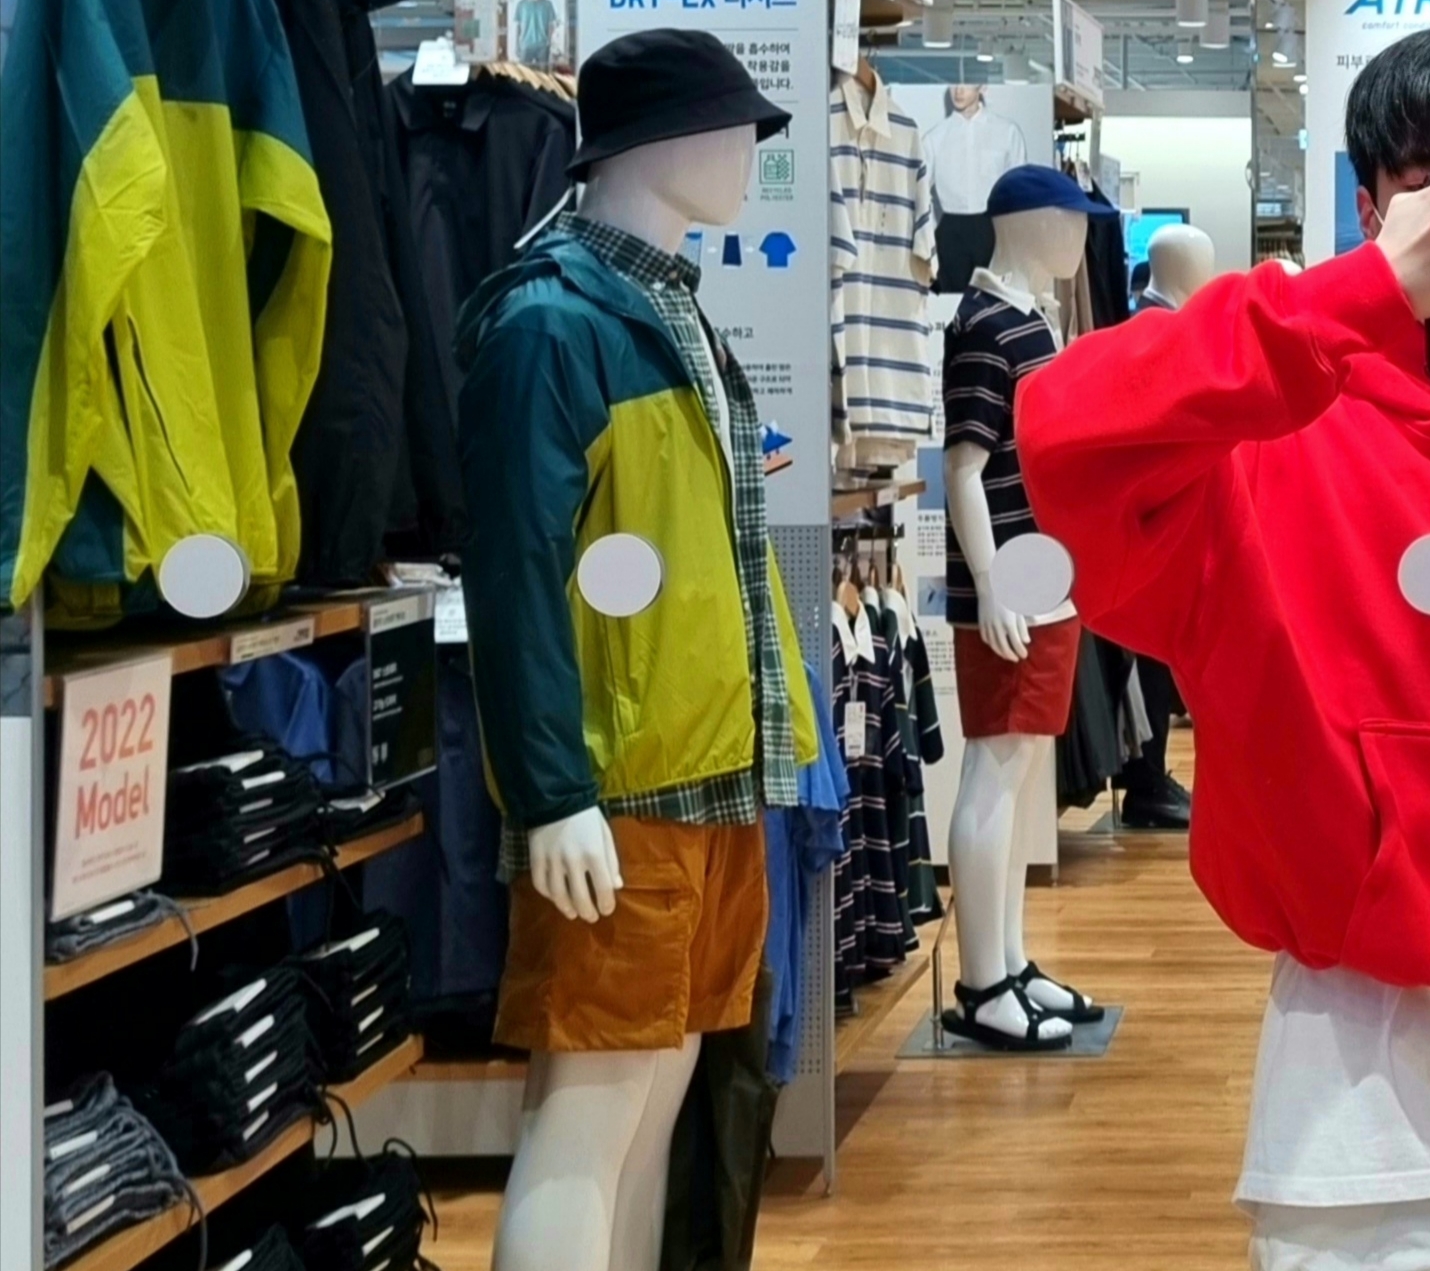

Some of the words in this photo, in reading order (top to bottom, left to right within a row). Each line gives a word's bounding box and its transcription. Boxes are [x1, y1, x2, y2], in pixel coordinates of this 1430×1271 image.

[749, 41, 790, 56] 흡수하여
[79, 692, 156, 771] 2022
[74, 764, 150, 840] Model
